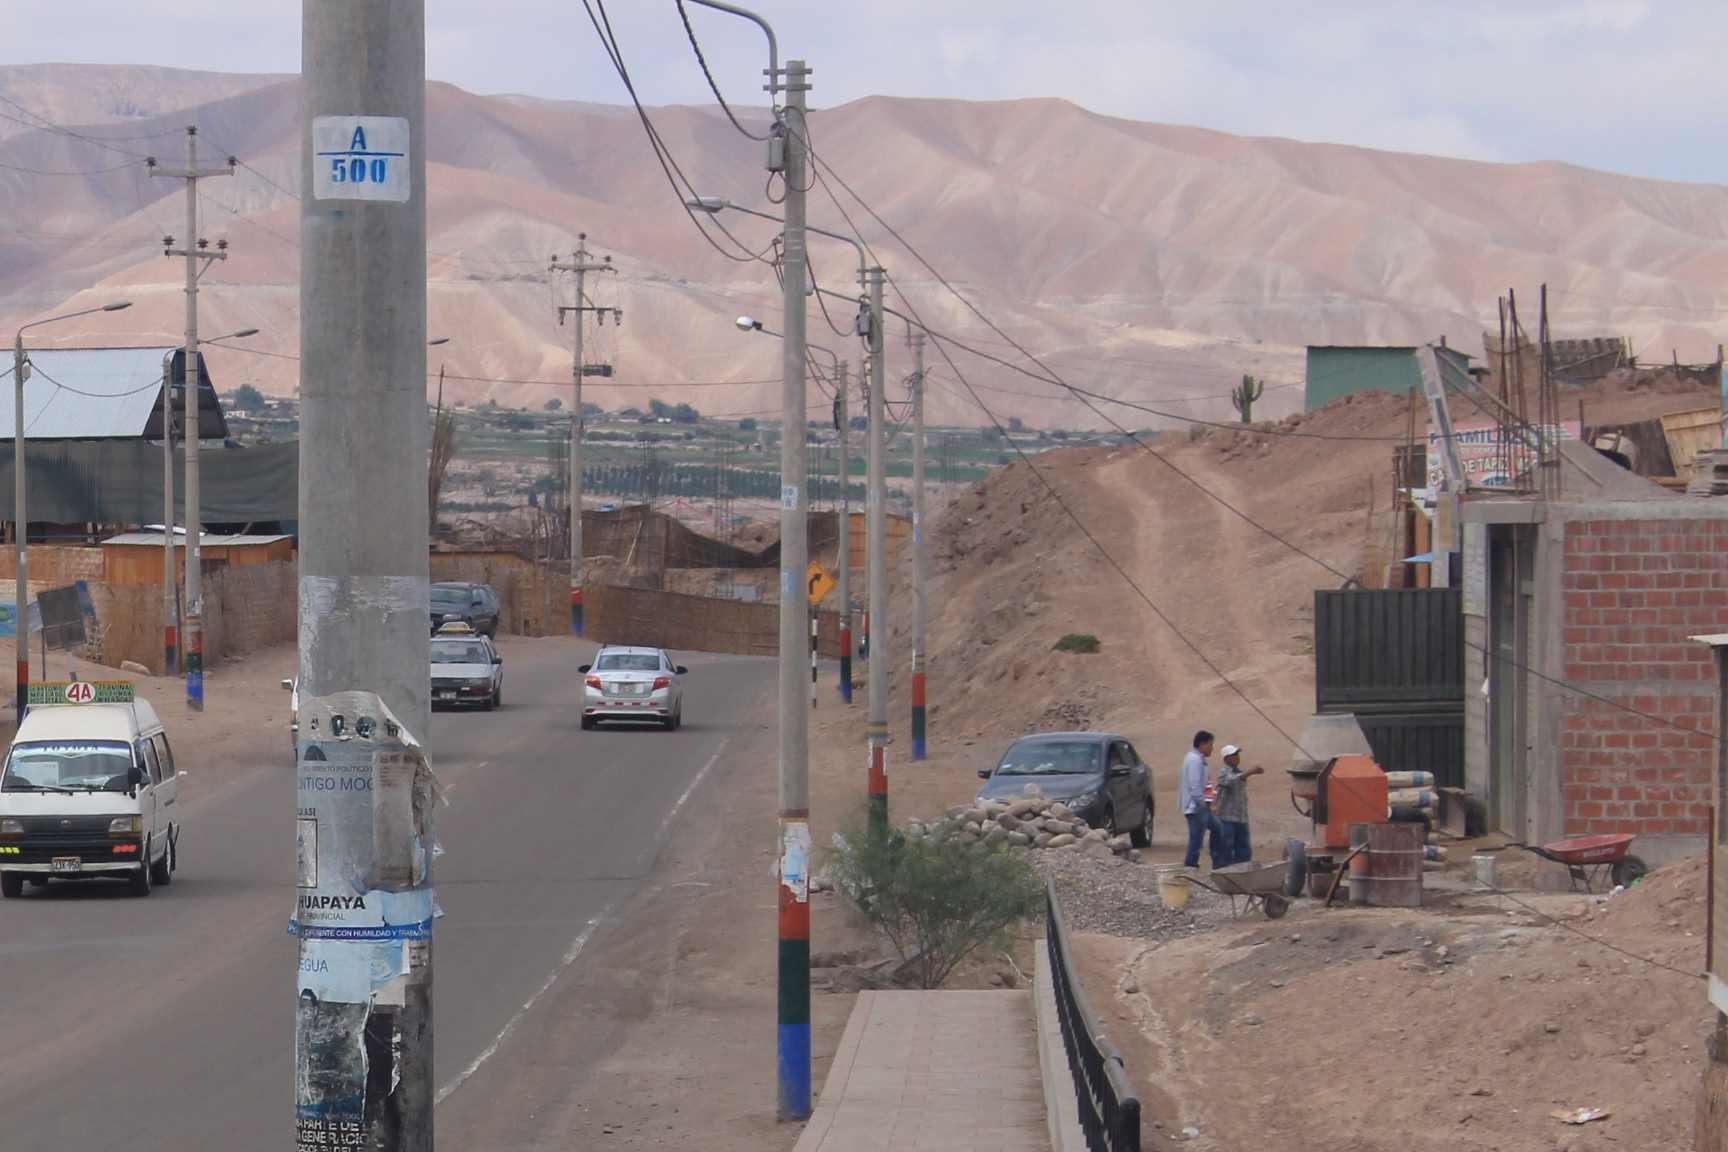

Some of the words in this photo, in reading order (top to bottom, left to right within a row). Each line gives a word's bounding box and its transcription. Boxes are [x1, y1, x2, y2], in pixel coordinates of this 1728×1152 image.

[350, 126, 366, 150] A
[332, 159, 386, 183] 500
[67, 683, 92, 702] 4A
[298, 895, 366, 910] HUAPAYA
[335, 929, 352, 937] CON
[353, 929, 391, 938] HUMILDAD
